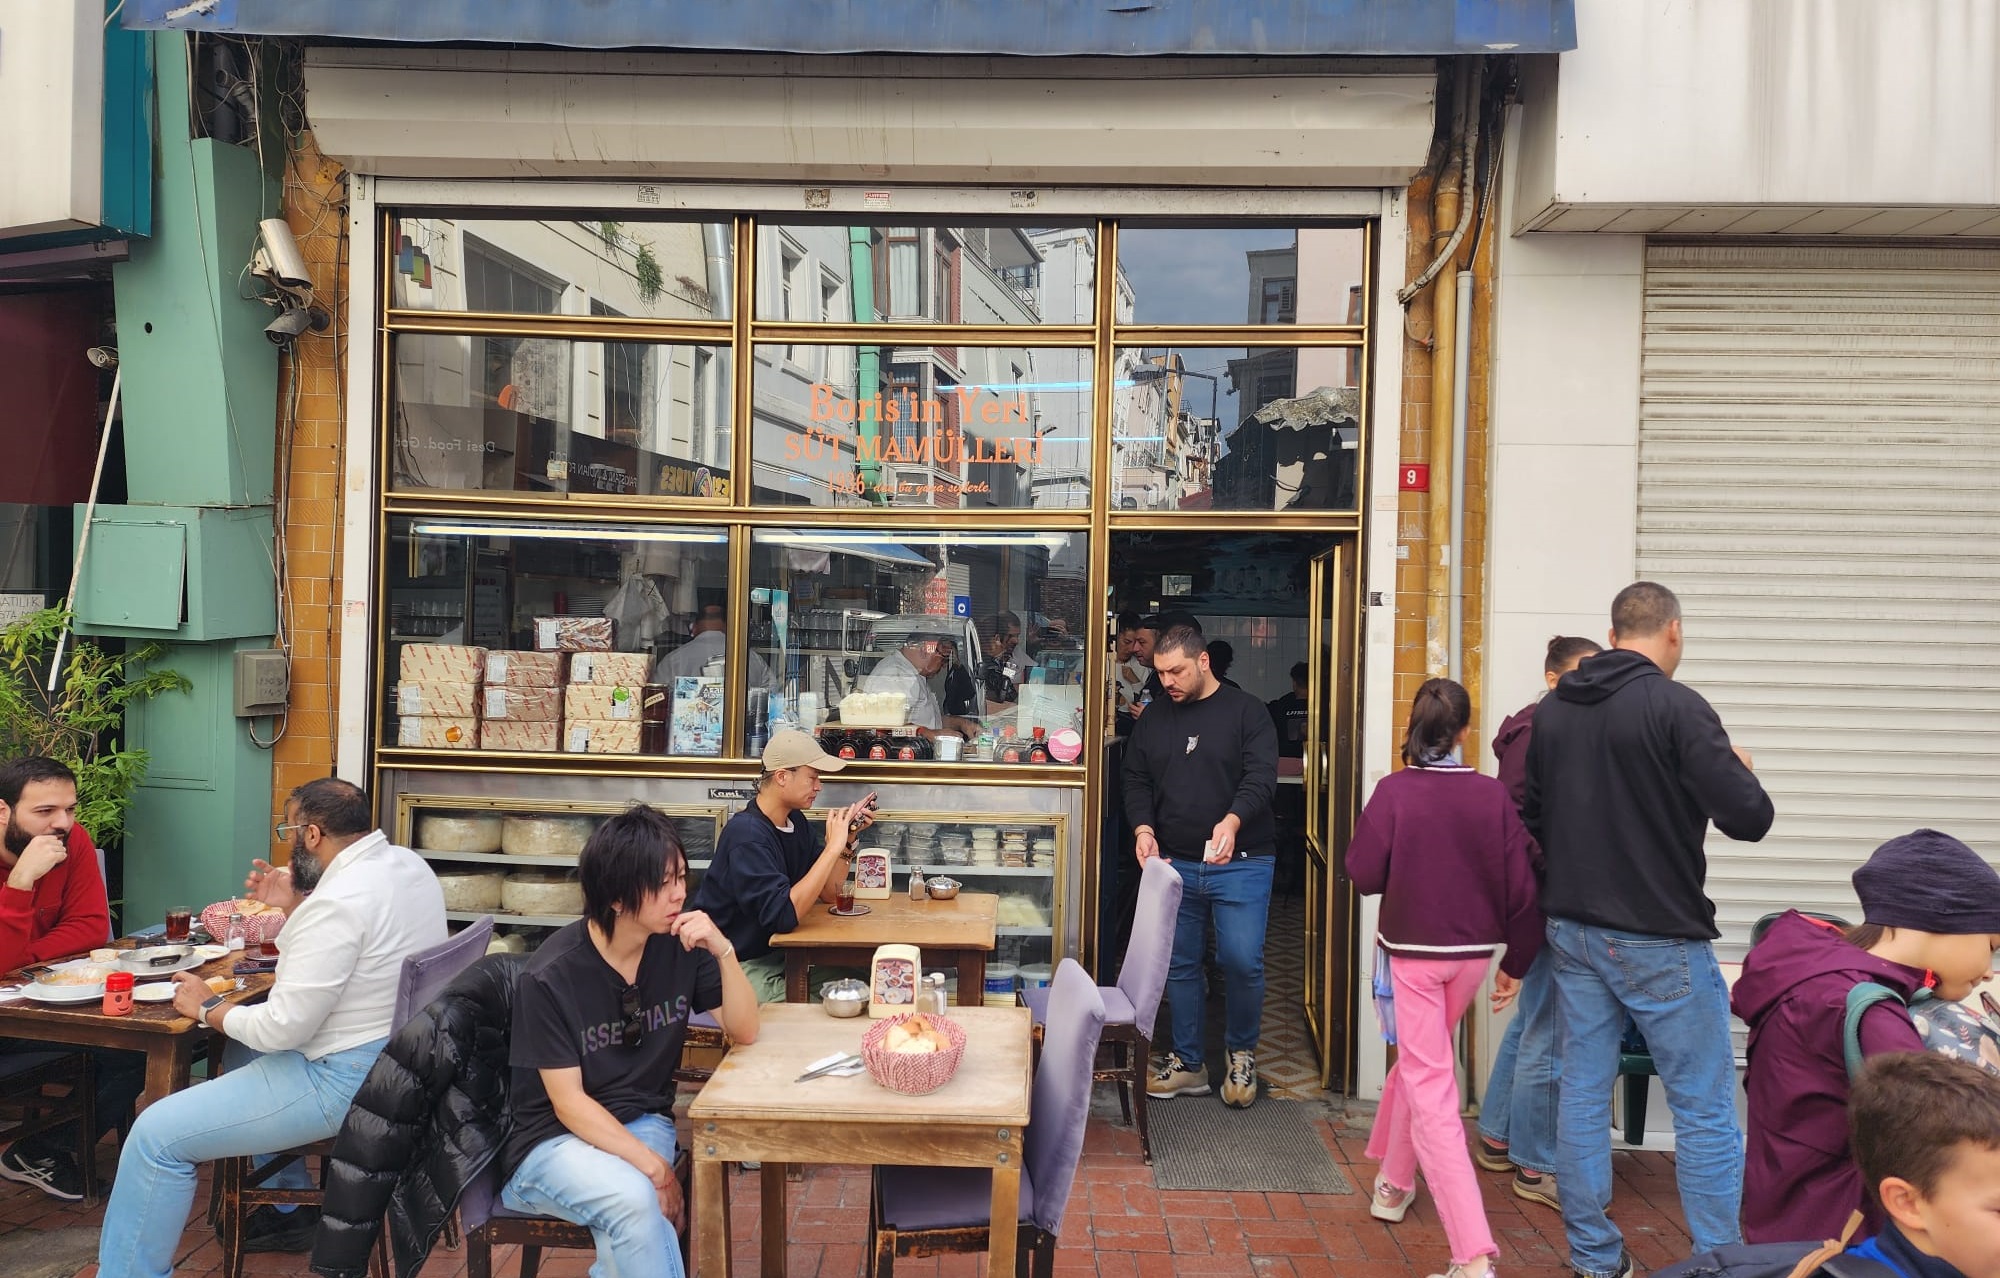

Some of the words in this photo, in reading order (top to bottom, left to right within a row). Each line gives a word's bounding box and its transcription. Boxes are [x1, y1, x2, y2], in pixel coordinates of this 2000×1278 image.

[809, 384, 943, 423] Boris'in
[956, 386, 1027, 424] Yeri
[784, 427, 849, 461] SÜT
[855, 429, 1045, 465] MAMÜLLERİ
[827, 470, 866, 495] 1936
[1406, 470, 1417, 485] 9
